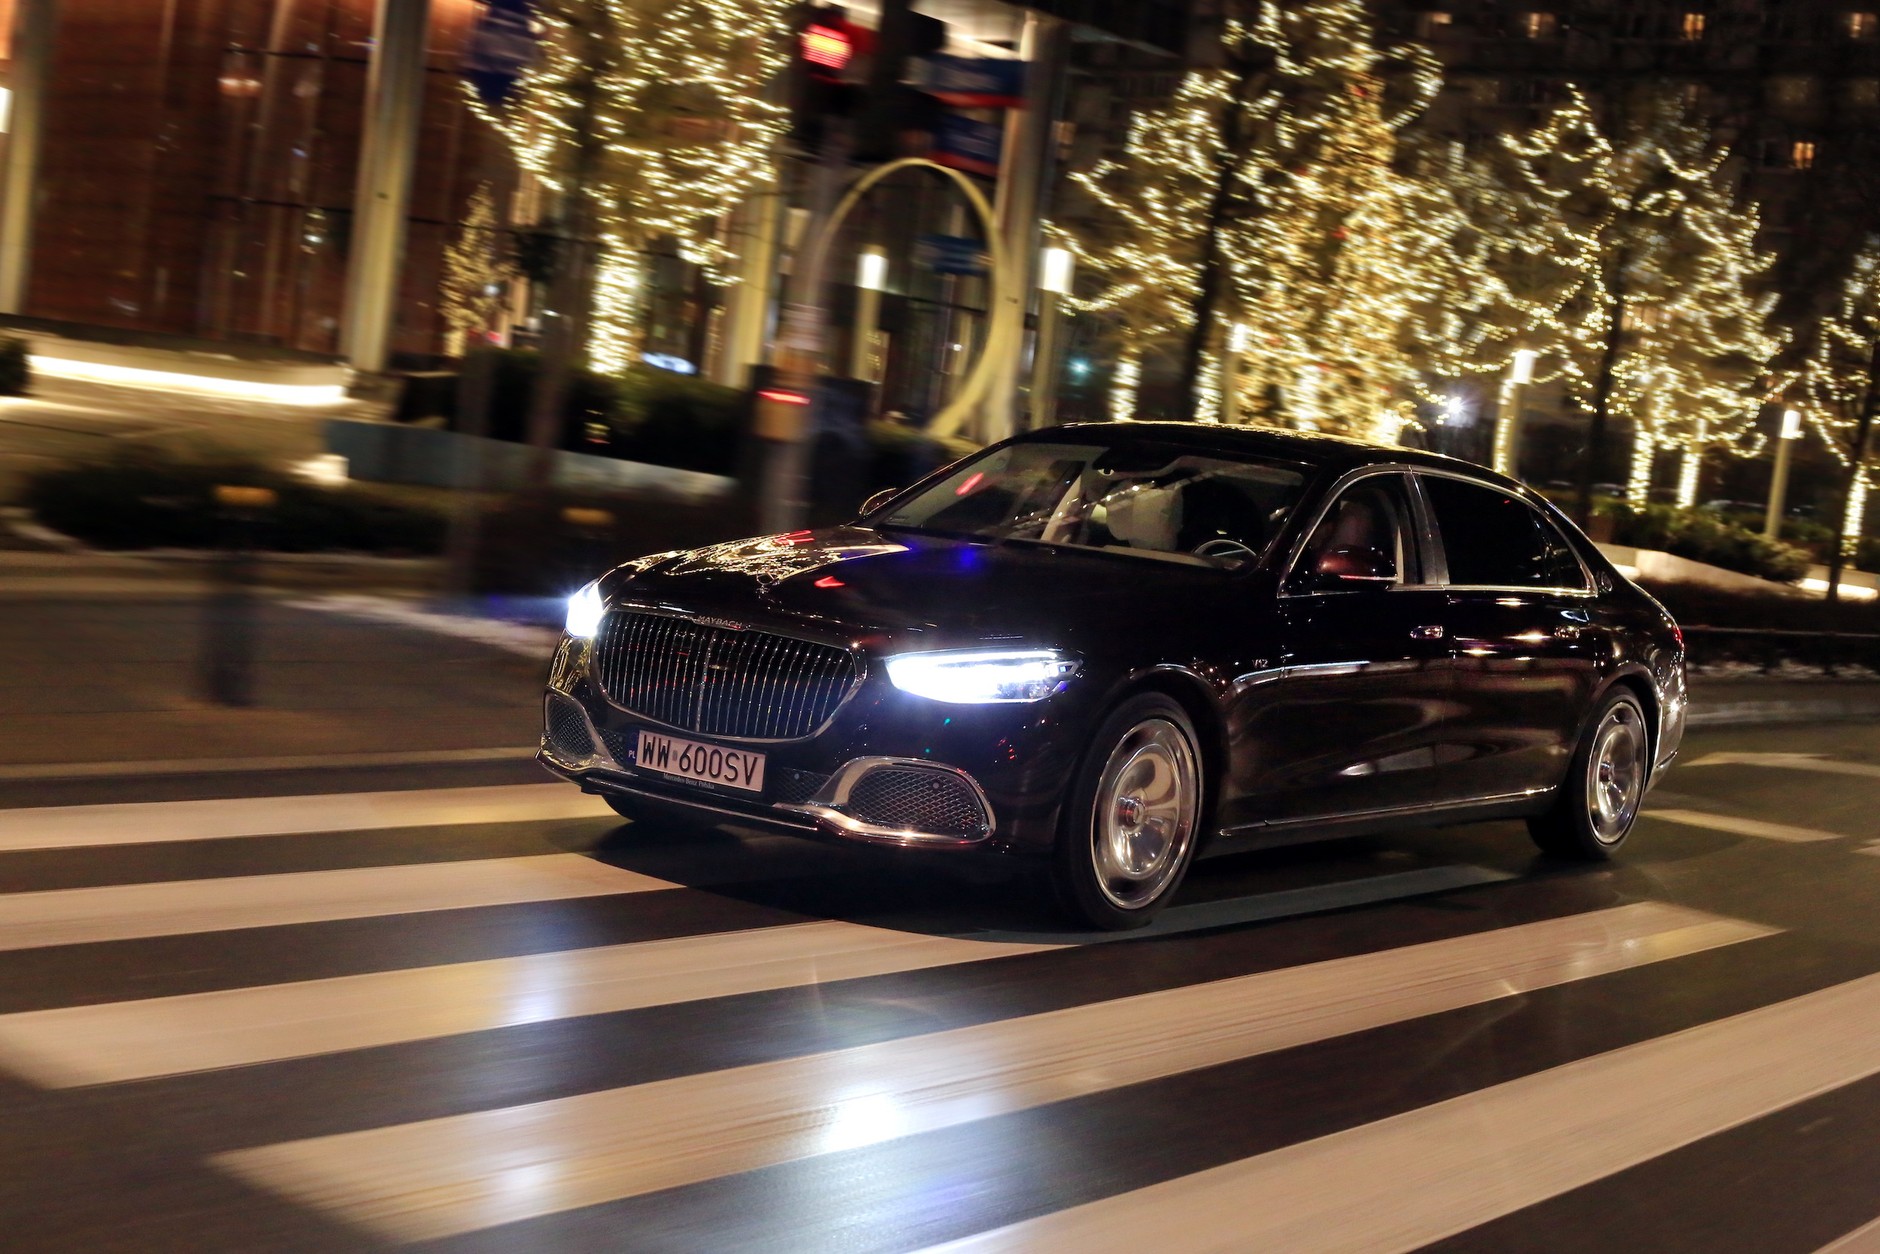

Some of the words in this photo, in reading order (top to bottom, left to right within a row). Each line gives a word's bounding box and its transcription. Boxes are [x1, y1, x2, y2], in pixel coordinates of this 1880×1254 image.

[698, 615, 743, 627] MAYBACH
[628, 750, 636, 759] PL
[642, 734, 671, 768] WW
[679, 744, 758, 786] 600SV
